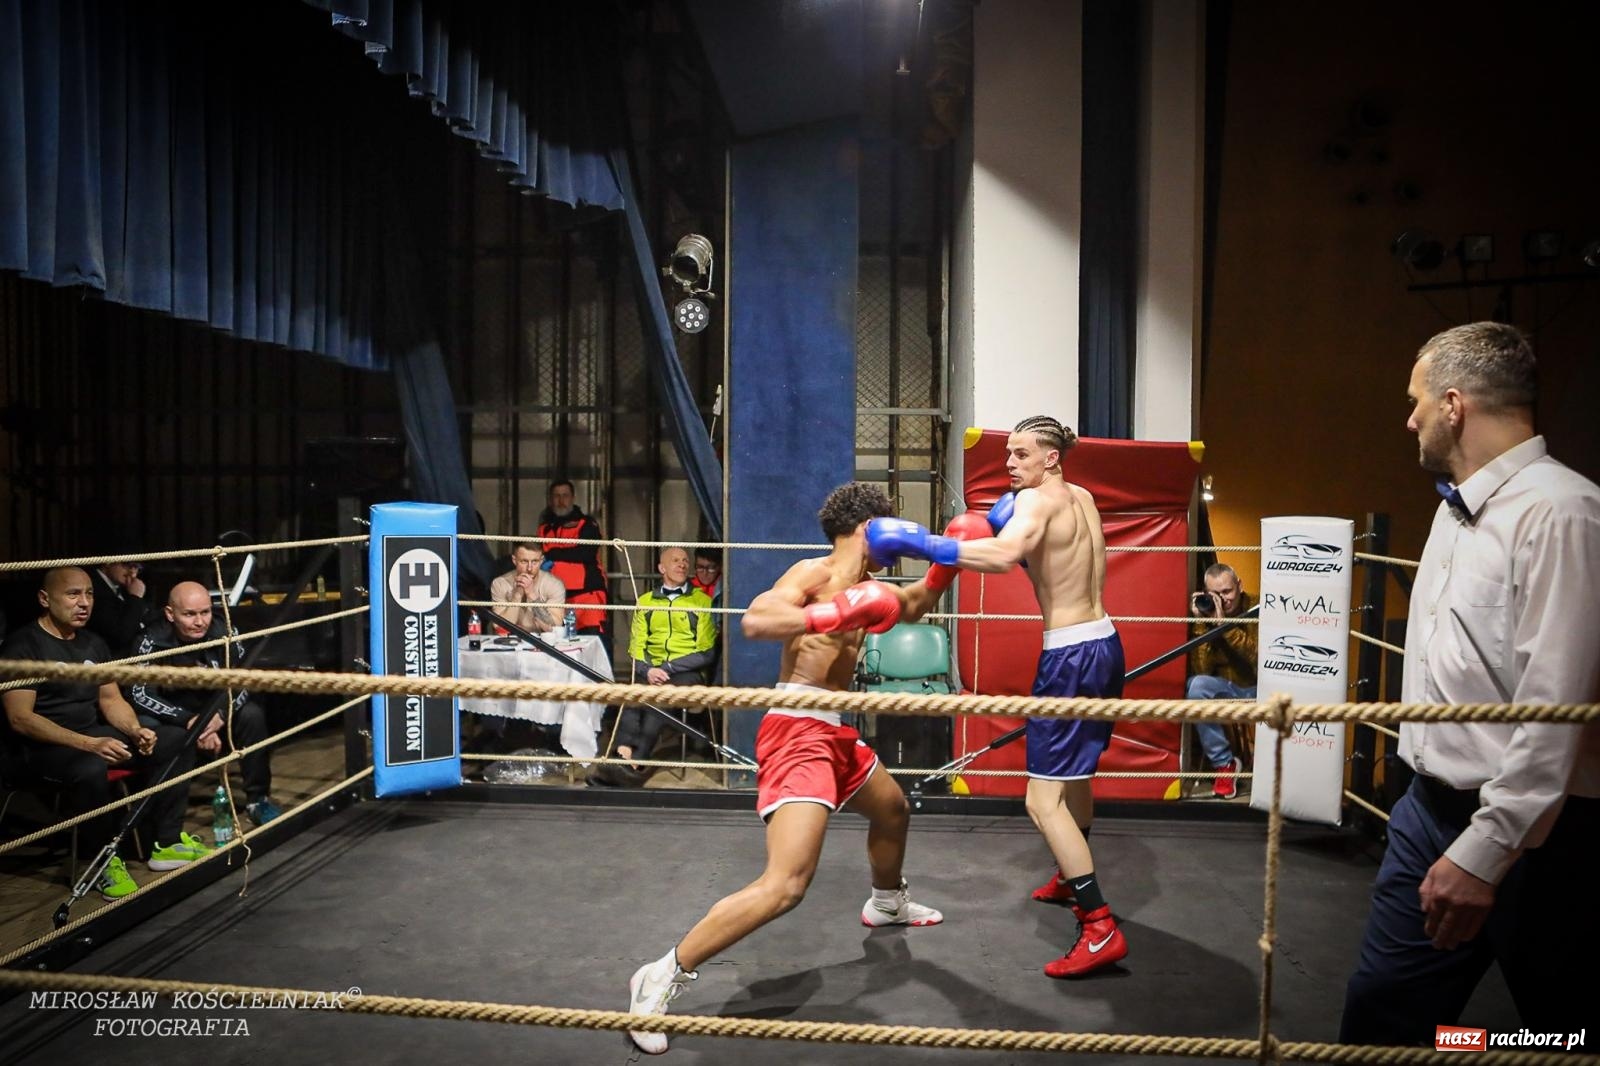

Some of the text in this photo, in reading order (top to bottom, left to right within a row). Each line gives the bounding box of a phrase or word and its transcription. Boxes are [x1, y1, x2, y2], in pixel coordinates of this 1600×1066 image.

[1264, 593, 1341, 615] RYWAL
[1297, 616, 1341, 628] SPORT
[424, 615, 440, 698] EXTRE
[404, 615, 421, 752] CONSTCTION
[1291, 735, 1335, 750] SPORT
